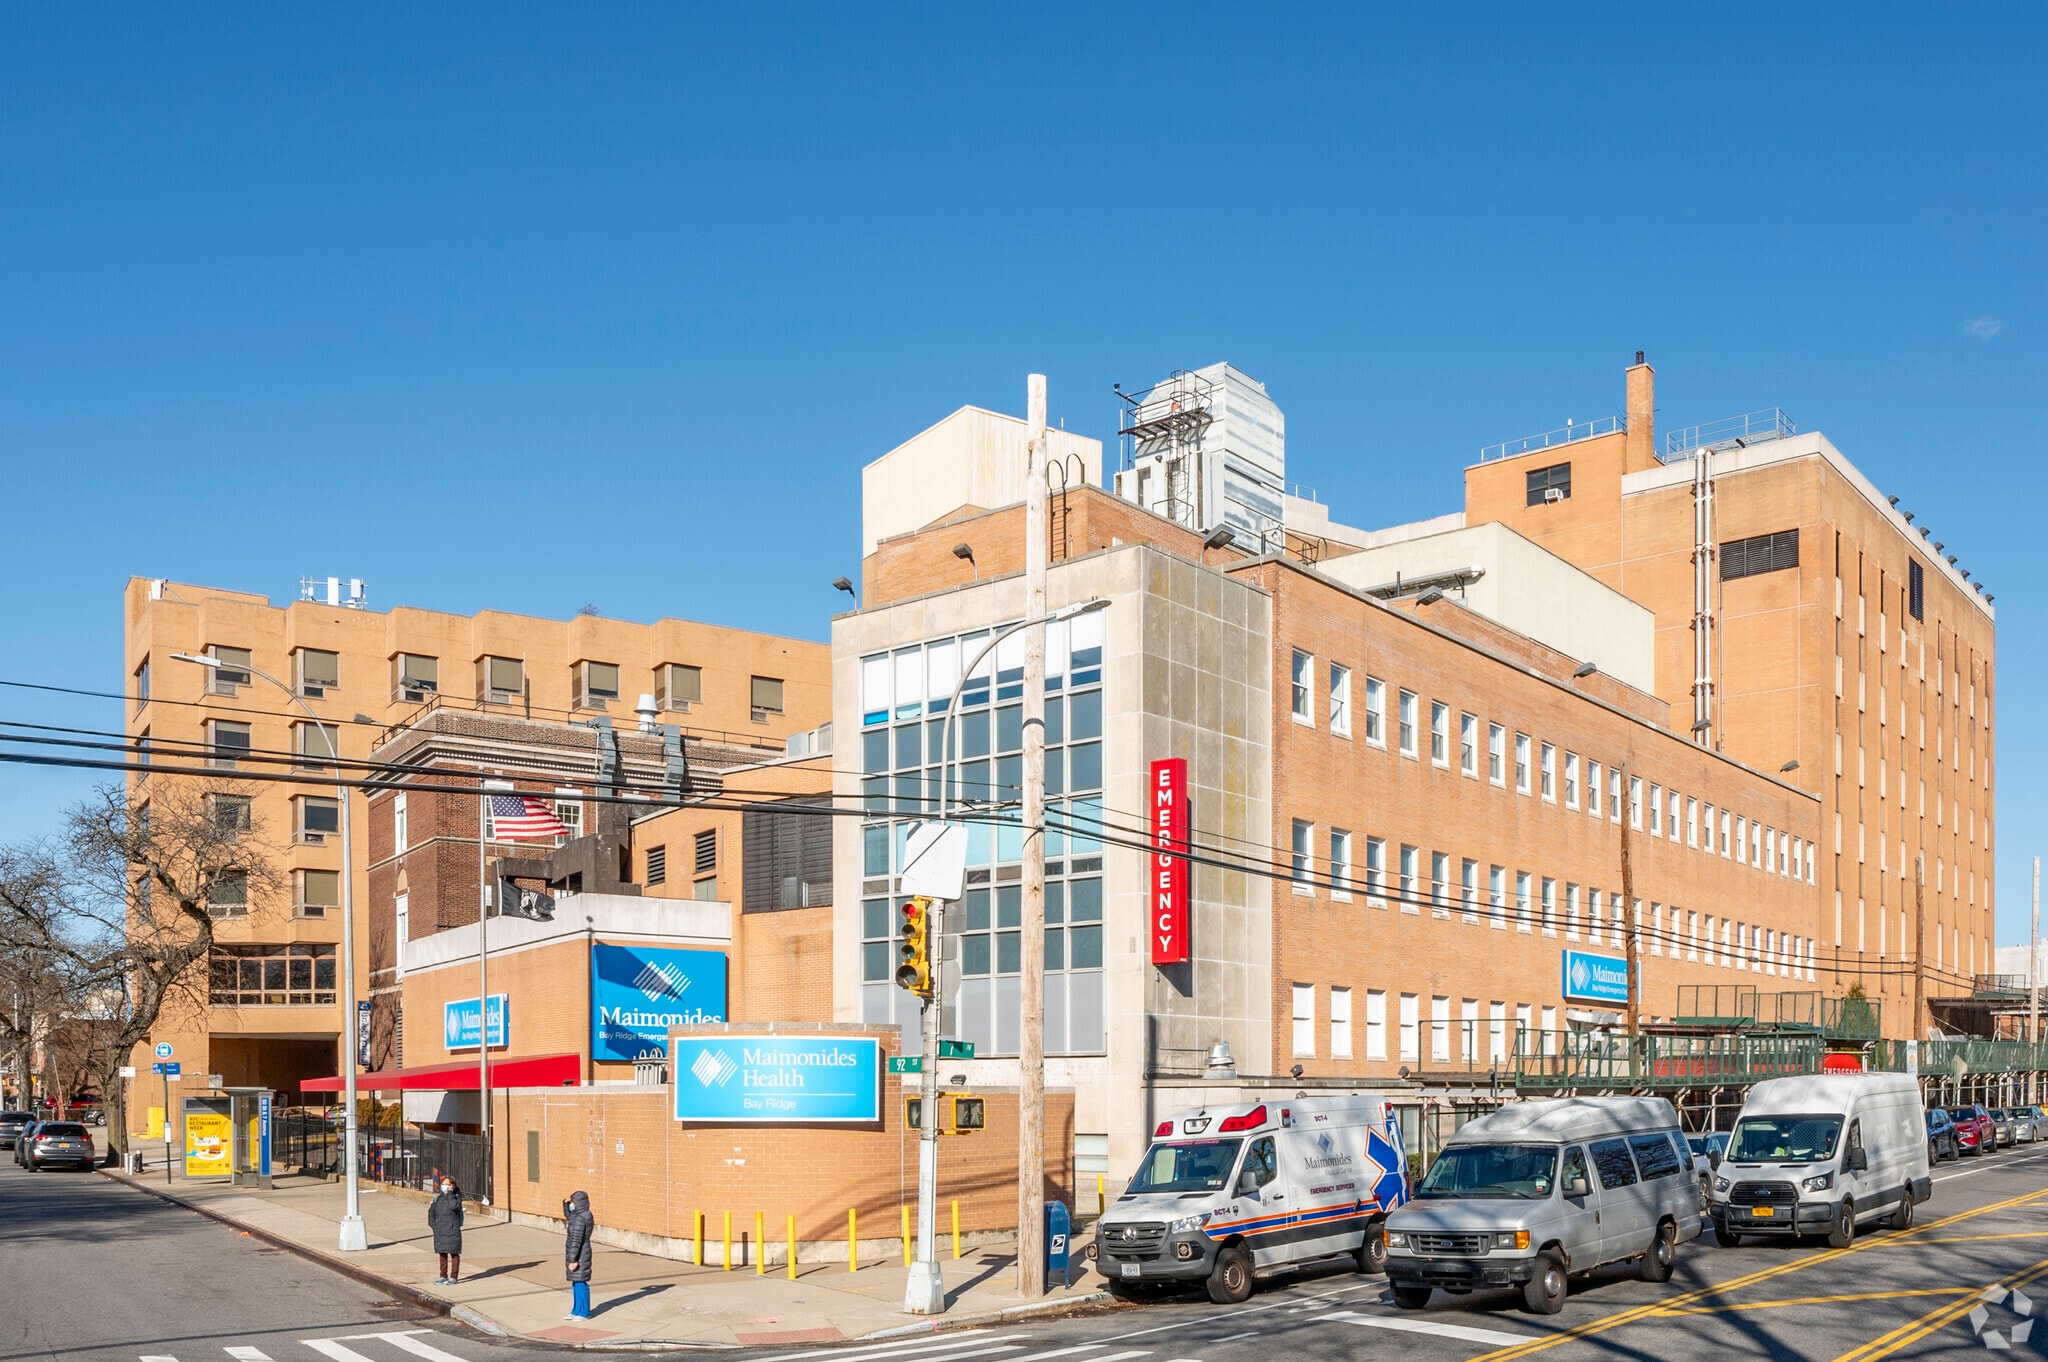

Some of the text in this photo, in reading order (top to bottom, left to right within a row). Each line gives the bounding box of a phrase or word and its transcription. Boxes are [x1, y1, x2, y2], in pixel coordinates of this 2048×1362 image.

[1157, 769, 1172, 953] EMERGENCY
[1592, 964, 1627, 984] Maimoni
[462, 1005, 499, 1029] Maimides
[599, 1006, 721, 1027] Maimonides
[599, 1031, 614, 1041] Bay
[615, 1031, 636, 1041] Ridge
[743, 1047, 857, 1067] Maimonides
[896, 1058, 918, 1071] 92 ST
[743, 1068, 805, 1088] Health
[743, 1098, 796, 1111] Bay Ridge
[1304, 1152, 1352, 1170] Maimonides
[1310, 1183, 1355, 1195] EMERGENCY SERVICES
